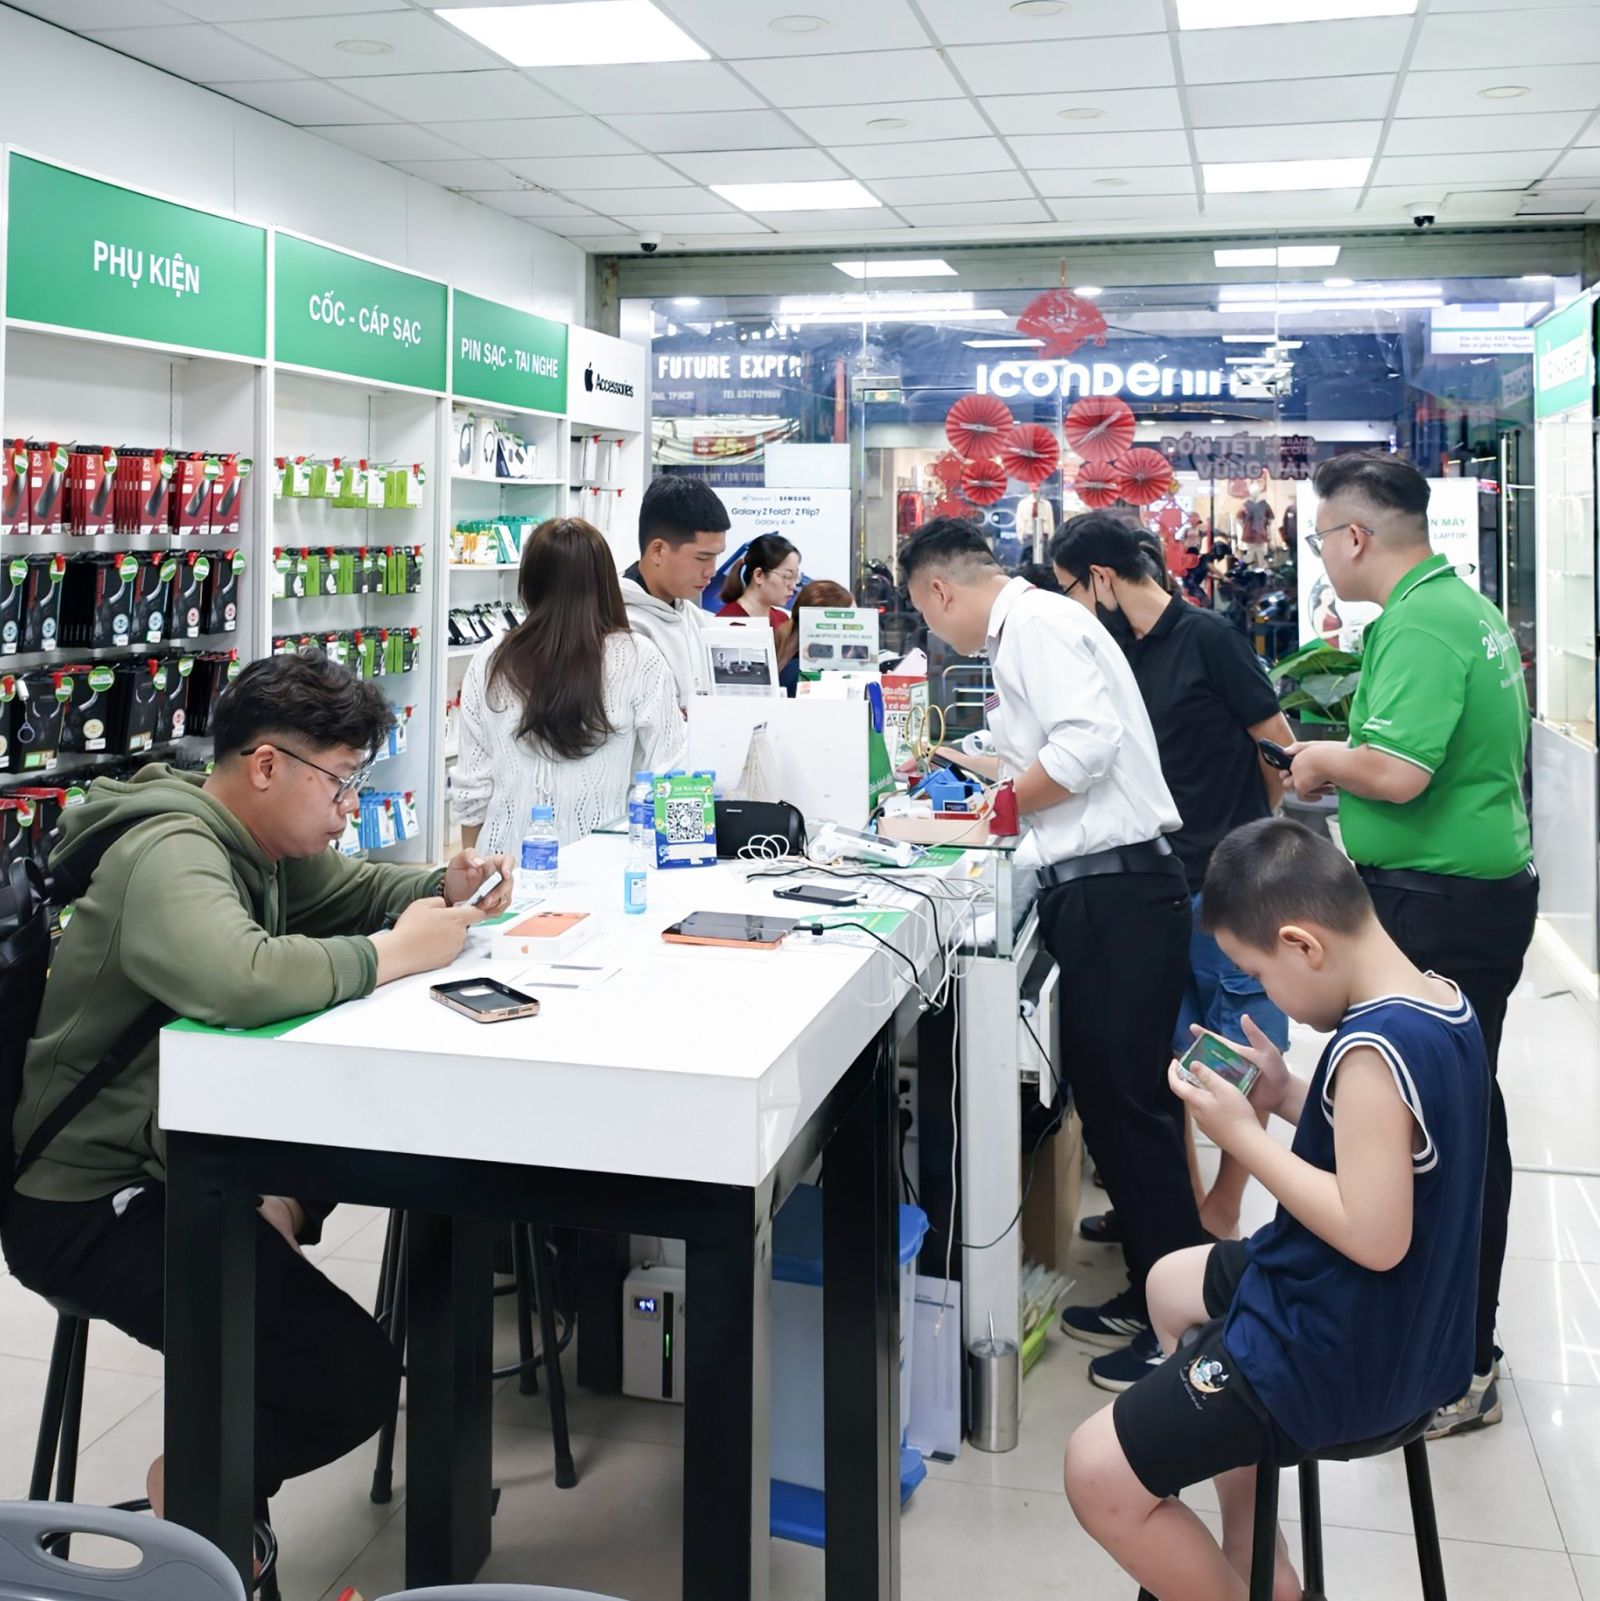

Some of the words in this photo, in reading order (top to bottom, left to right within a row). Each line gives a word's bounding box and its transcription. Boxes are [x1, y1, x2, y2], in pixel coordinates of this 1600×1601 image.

[93, 239, 144, 289] PHỤ
[149, 252, 200, 298] KIỆN
[309, 290, 346, 327] CỐC
[358, 304, 390, 337] CÁP
[392, 315, 422, 349] SẠC
[461, 337, 481, 363] PIN
[483, 344, 507, 372] SẠC
[515, 350, 531, 372] TAI
[531, 353, 559, 379] NGHE
[658, 355, 731, 379] FUTURE
[595, 373, 635, 398] Accessories
[1216, 430, 1262, 455] TẾT
[731, 507, 762, 517] Galaxy
[762, 508, 768, 516] Z
[768, 507, 792, 516] Fold7
[795, 508, 801, 516] Z
[801, 508, 820, 518] Flip7
[1434, 532, 1468, 540] LAPTOP
